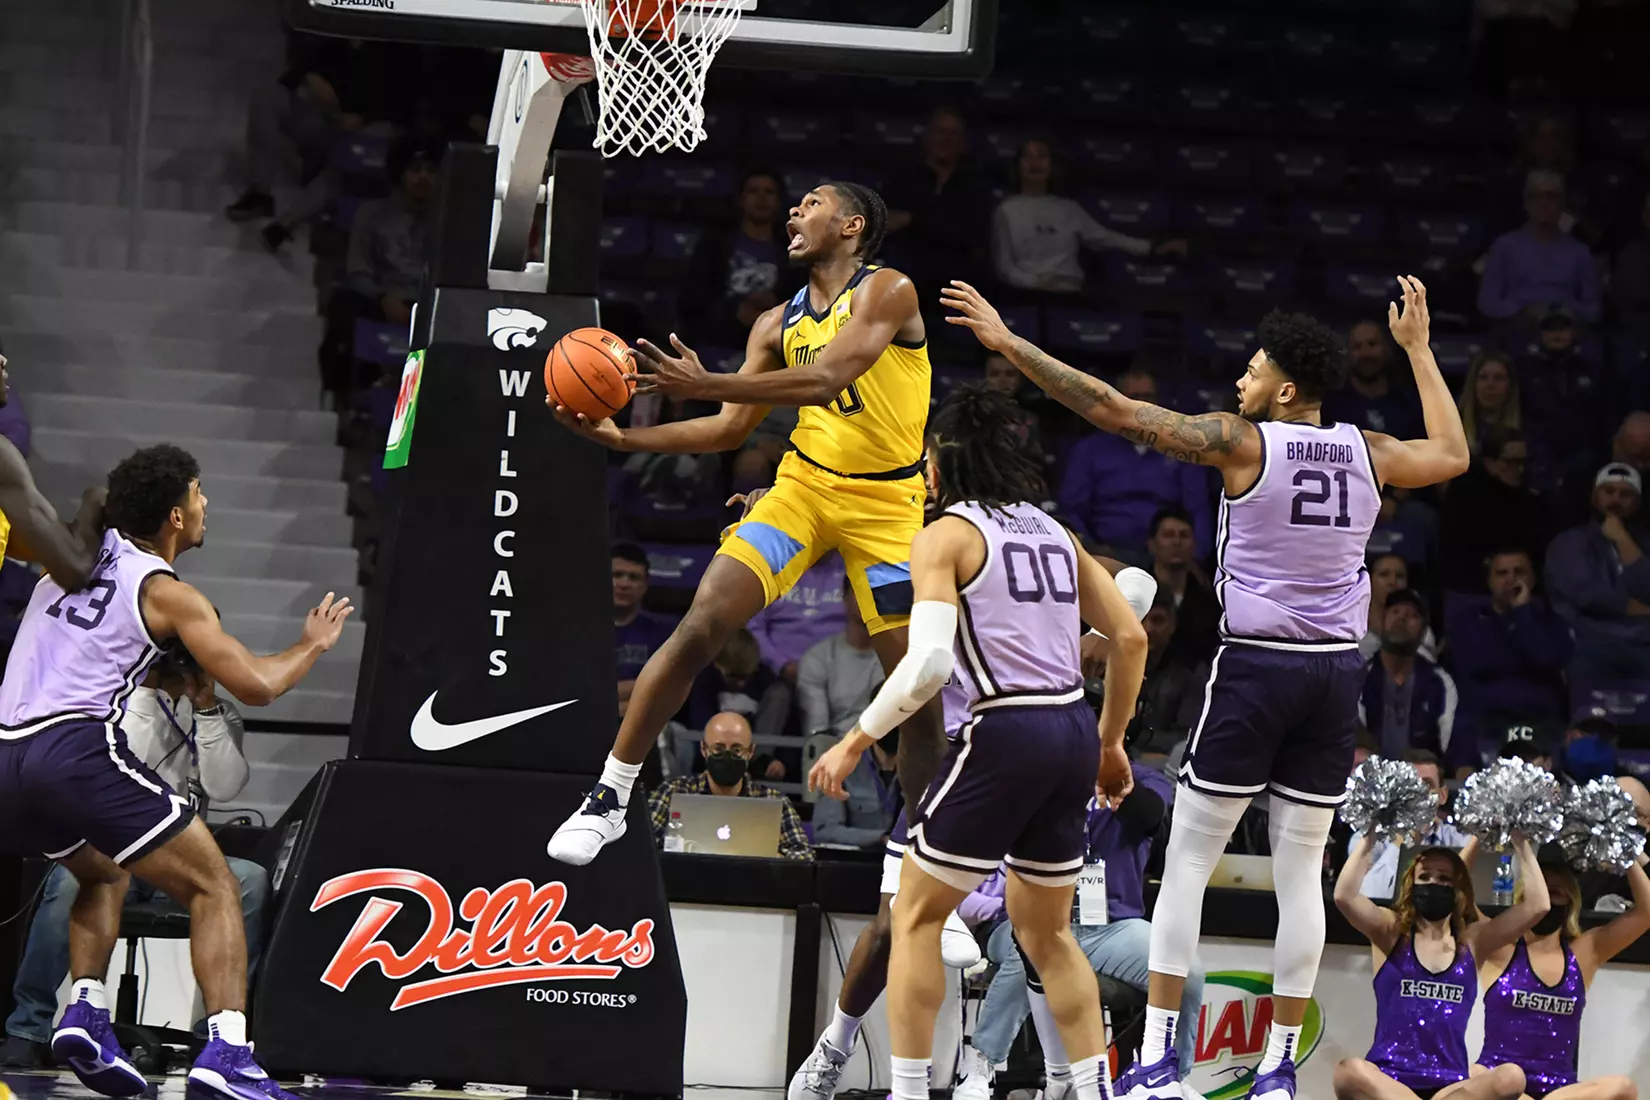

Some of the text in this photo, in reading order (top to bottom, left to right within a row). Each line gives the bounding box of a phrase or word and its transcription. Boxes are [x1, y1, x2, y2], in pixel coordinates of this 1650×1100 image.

[1286, 441, 1353, 463] BRADFORD
[1290, 469, 1351, 528] 21
[488, 369, 532, 676] WILDCATS
[1002, 541, 1077, 604] 00
[1507, 726, 1534, 742] KC
[310, 867, 655, 992] Dillons
[526, 988, 569, 1004] FOOD
[1401, 979, 1464, 1003] K-STATE
[1513, 989, 1578, 1015] K-STATE
